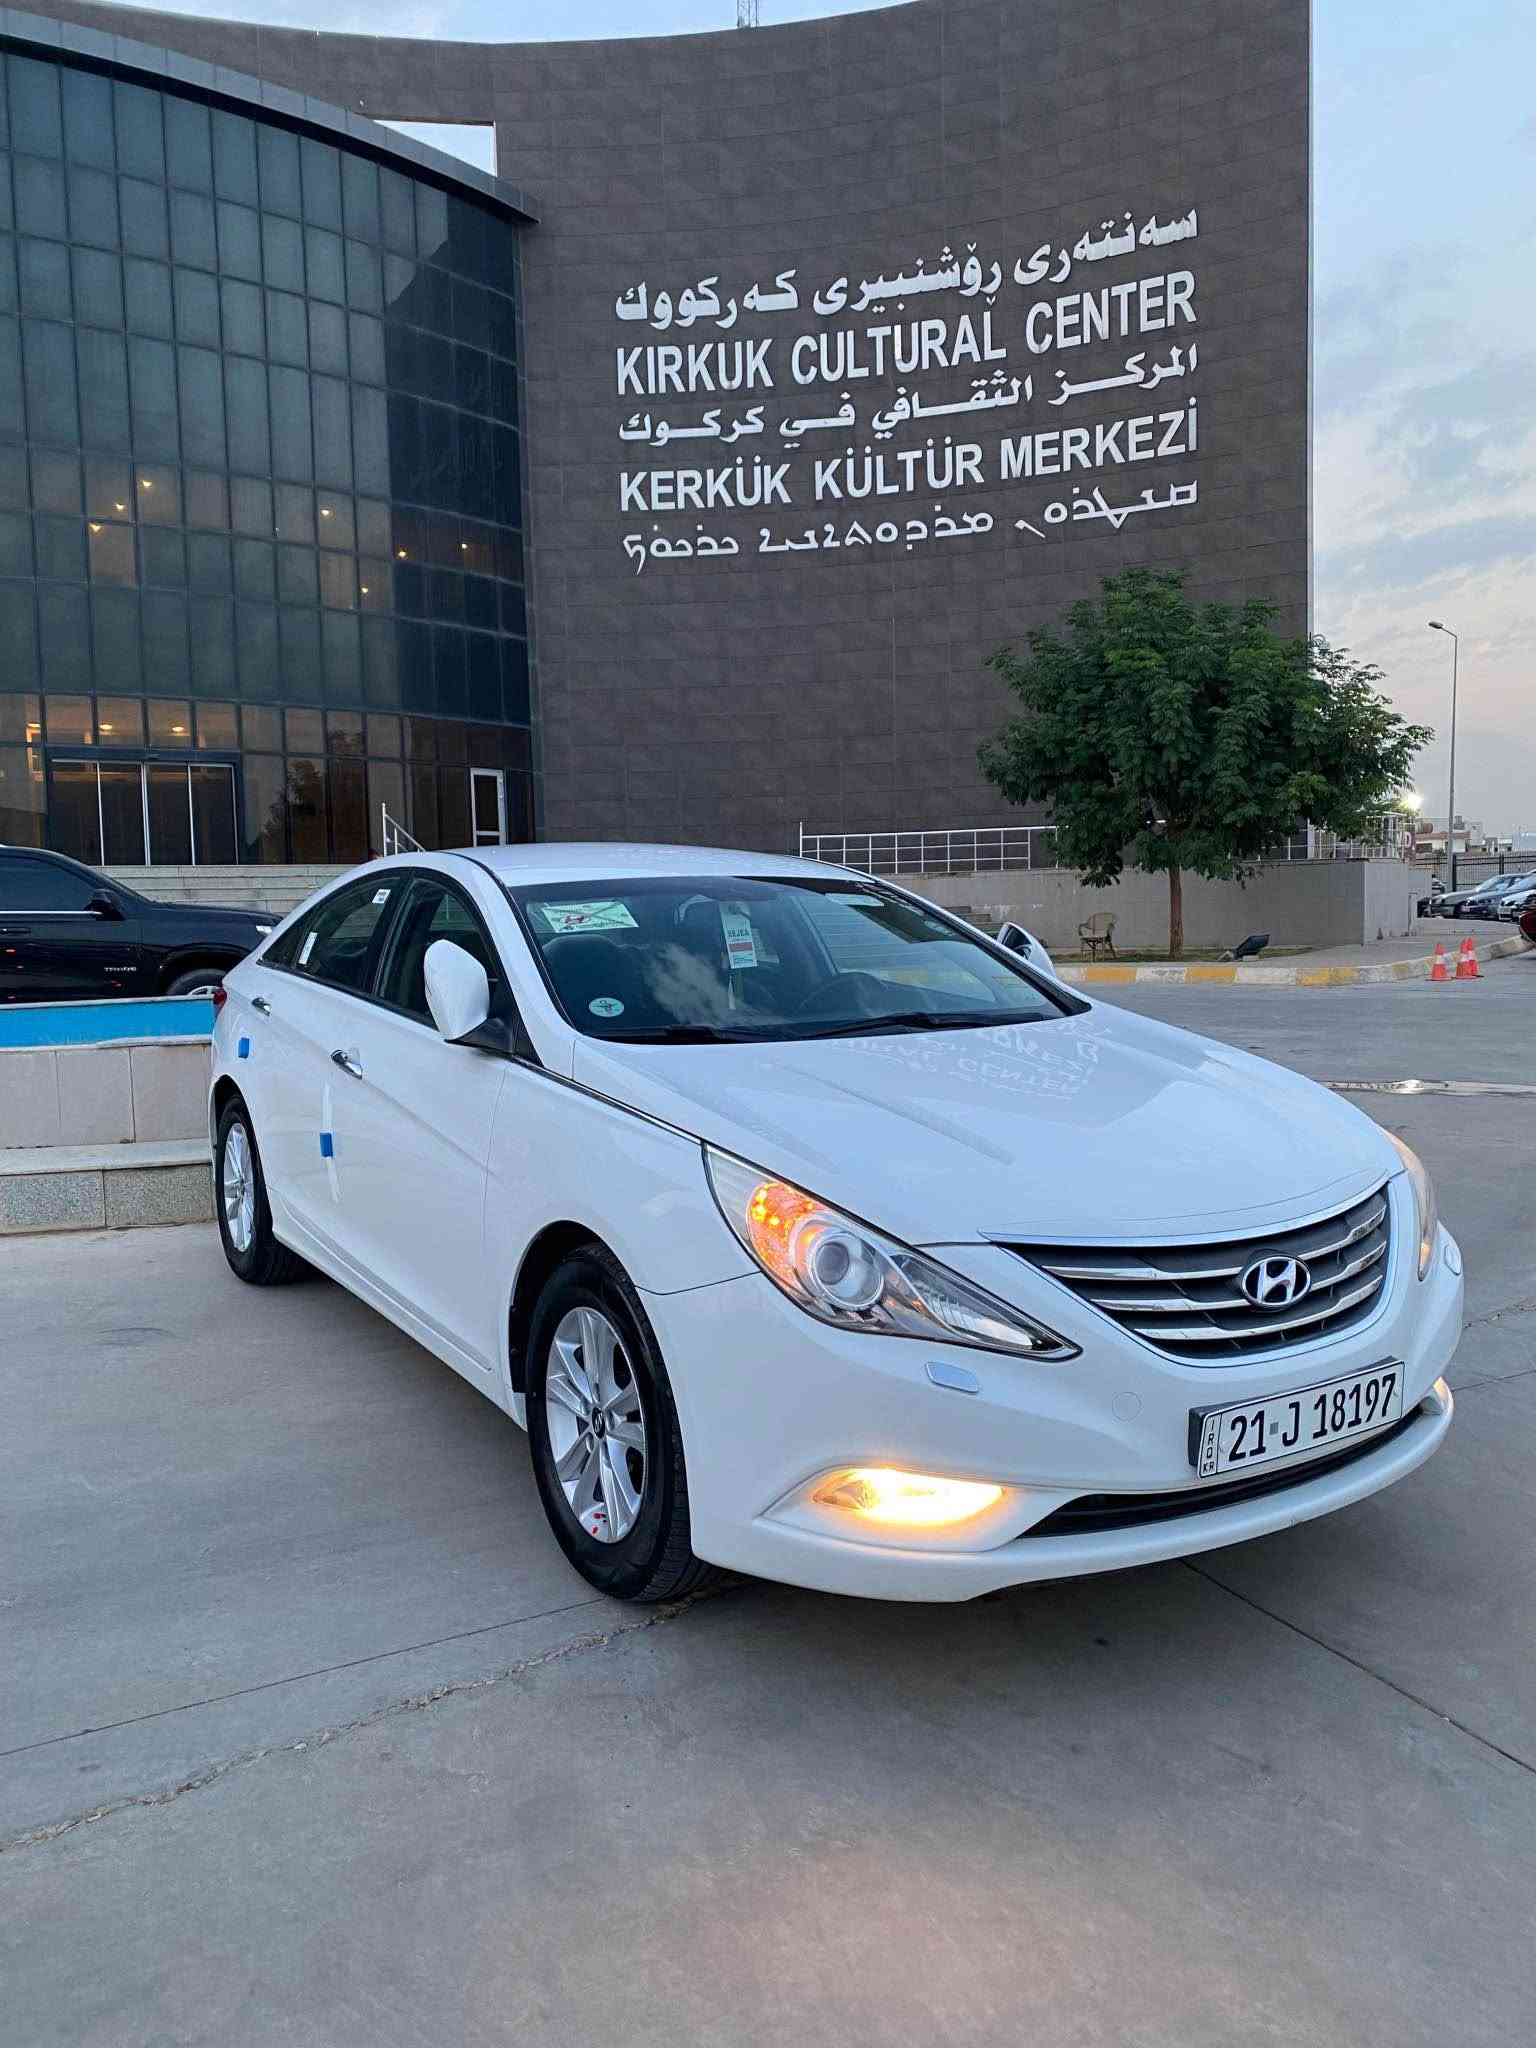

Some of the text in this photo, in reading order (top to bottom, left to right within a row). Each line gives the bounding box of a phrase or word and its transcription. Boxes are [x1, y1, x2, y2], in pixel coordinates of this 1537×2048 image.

[616, 270, 1197, 396] KIRKUK CULTURAL CENTER
[618, 342, 1198, 449] المركز الثقافي في كركوك
[620, 396, 1197, 512] KERKÜK KÜLTÜR MERKEZİ
[1228, 1372, 1397, 1462] 21 J 18197
